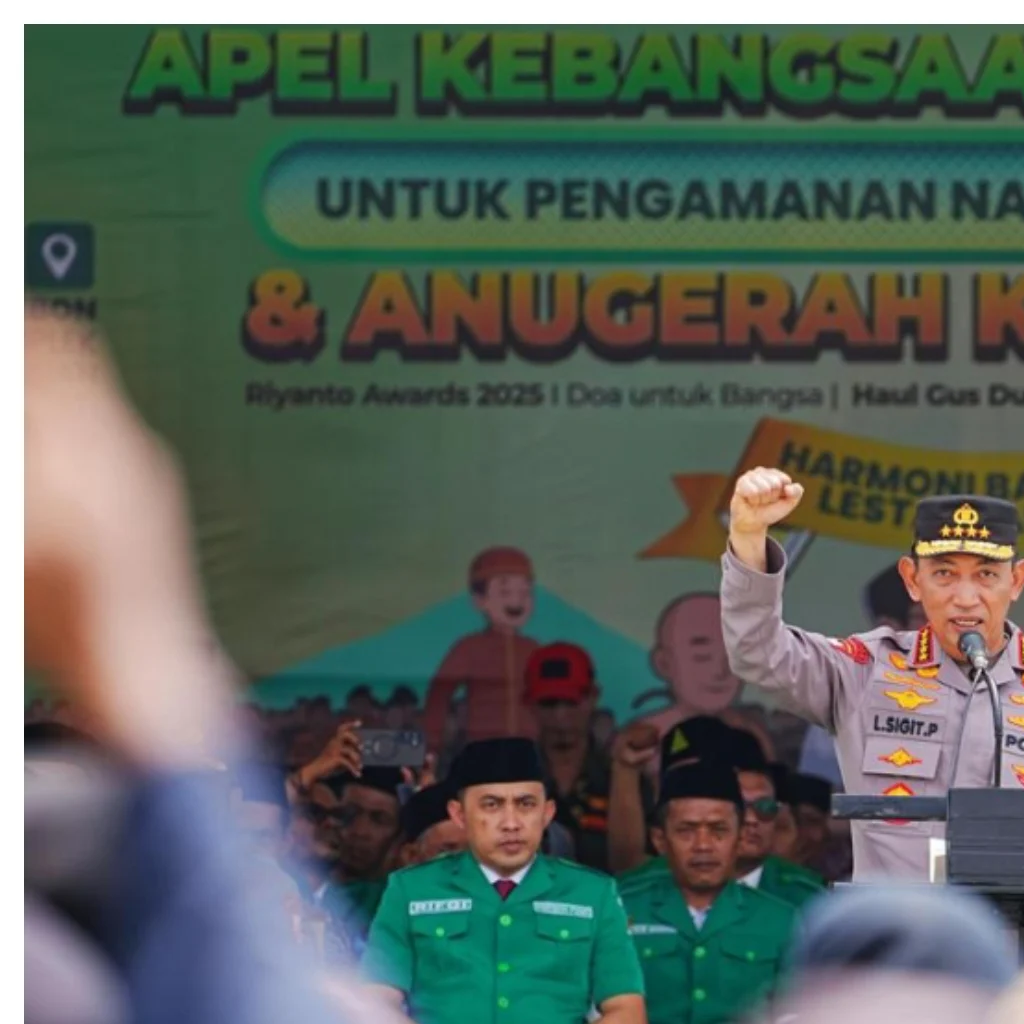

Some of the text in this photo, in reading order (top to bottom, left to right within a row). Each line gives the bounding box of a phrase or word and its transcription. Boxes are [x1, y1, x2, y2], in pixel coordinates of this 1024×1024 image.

[122, 29, 398, 118] APEL
[316, 178, 511, 222] UNTUK
[524, 178, 938, 222] PENGAMANAN
[242, 268, 327, 364] &
[342, 270, 951, 363] ANUGERAH
[245, 382, 354, 411] Riyanto
[362, 382, 469, 406] Awards
[476, 382, 543, 406] 2025
[566, 383, 621, 406] Doa
[628, 382, 711, 406] untuk
[720, 383, 825, 411] Bangsa
[852, 382, 918, 406] Haul
[925, 383, 980, 406] Gus
[780, 440, 976, 496] HARMONI
[818, 485, 914, 527] LEST
[873, 714, 939, 738] L.SIGIT.P
